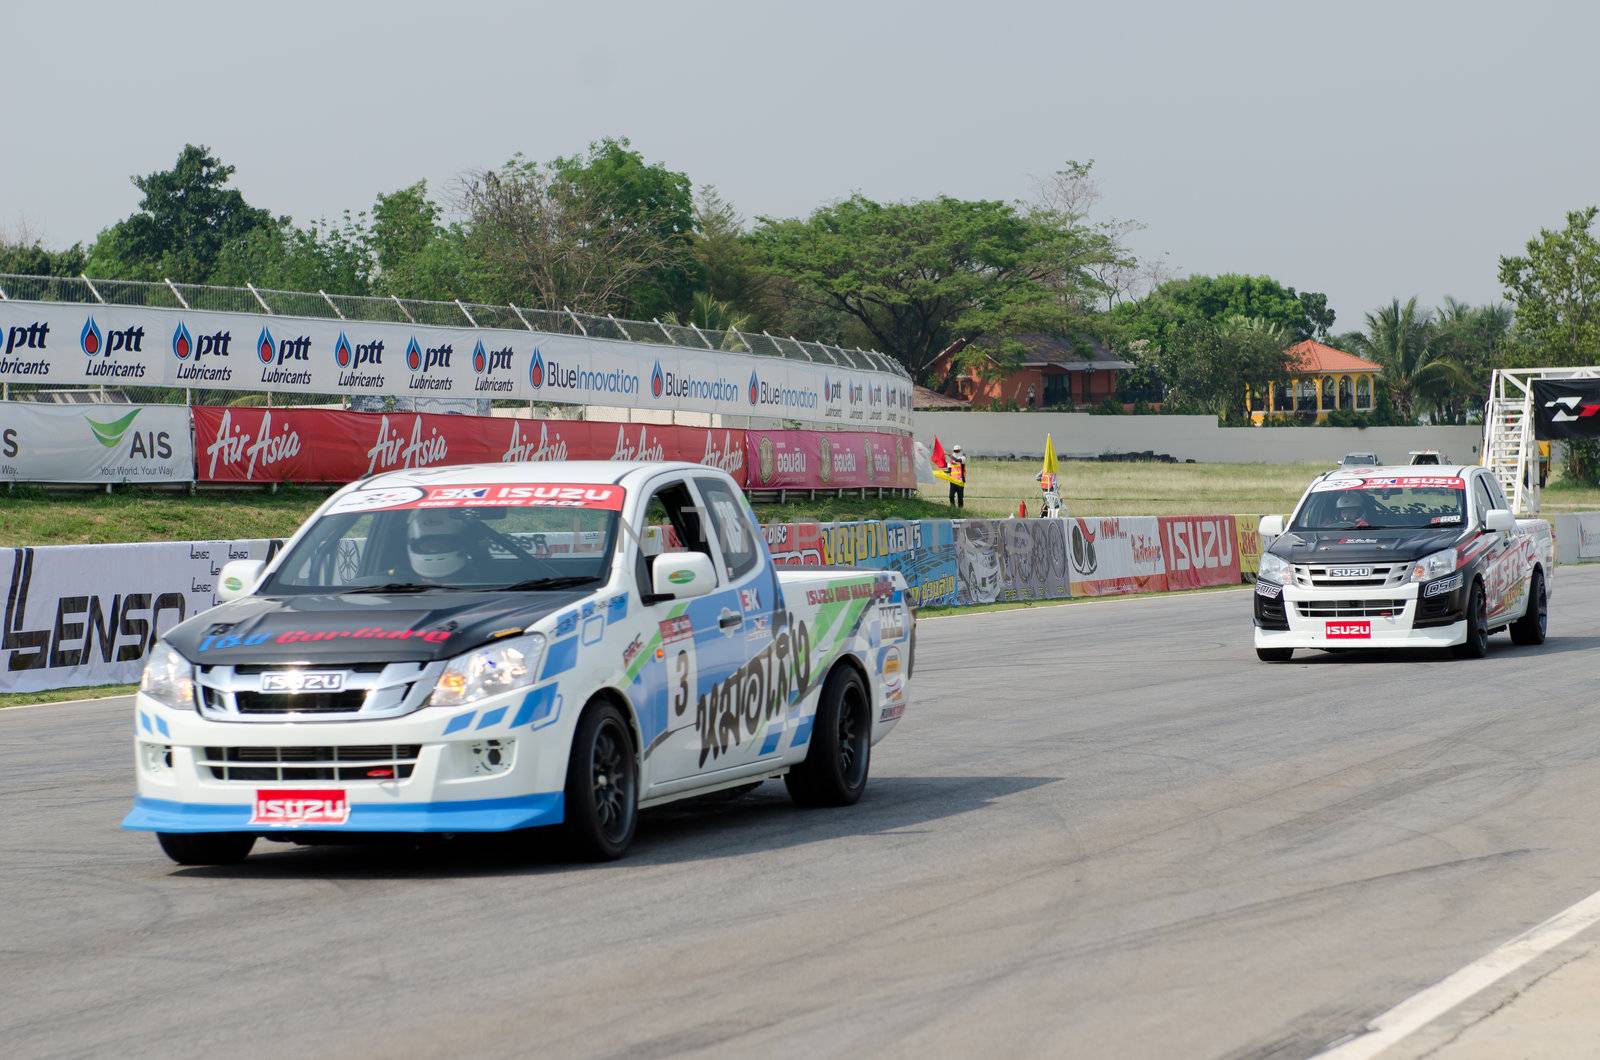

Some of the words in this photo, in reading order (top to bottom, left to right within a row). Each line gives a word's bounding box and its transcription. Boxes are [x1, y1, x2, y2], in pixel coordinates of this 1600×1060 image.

[5, 322, 50, 355] ptt
[105, 325, 145, 357] ptt
[195, 330, 232, 361] ptt
[277, 336, 312, 365] ptt
[353, 339, 384, 369] ptt
[423, 344, 453, 372] ptt
[0, 357, 51, 375] bricants
[84, 360, 146, 377] Lubricants
[487, 347, 514, 374] ptt
[176, 364, 232, 381] Lubricants
[261, 367, 312, 386] Lubricants
[338, 371, 384, 388] Lubricants
[409, 374, 452, 391] Lubricants
[474, 376, 514, 392] Lubricants
[129, 431, 172, 459] AIS
[100, 466, 116, 476] Your
[117, 466, 139, 476] World.
[140, 466, 157, 476] Your
[497, 487, 612, 501] ISUZU
[190, 544, 210, 559] LENSO
[229, 544, 249, 559] LENSO
[1166, 519, 1232, 571] ISUZU
[1331, 568, 1369, 577] SUZU
[192, 577, 212, 592] LENSO
[1326, 625, 1370, 635] ISUZU
[675, 650, 689, 717] 3
[258, 799, 345, 818] ISUZU
